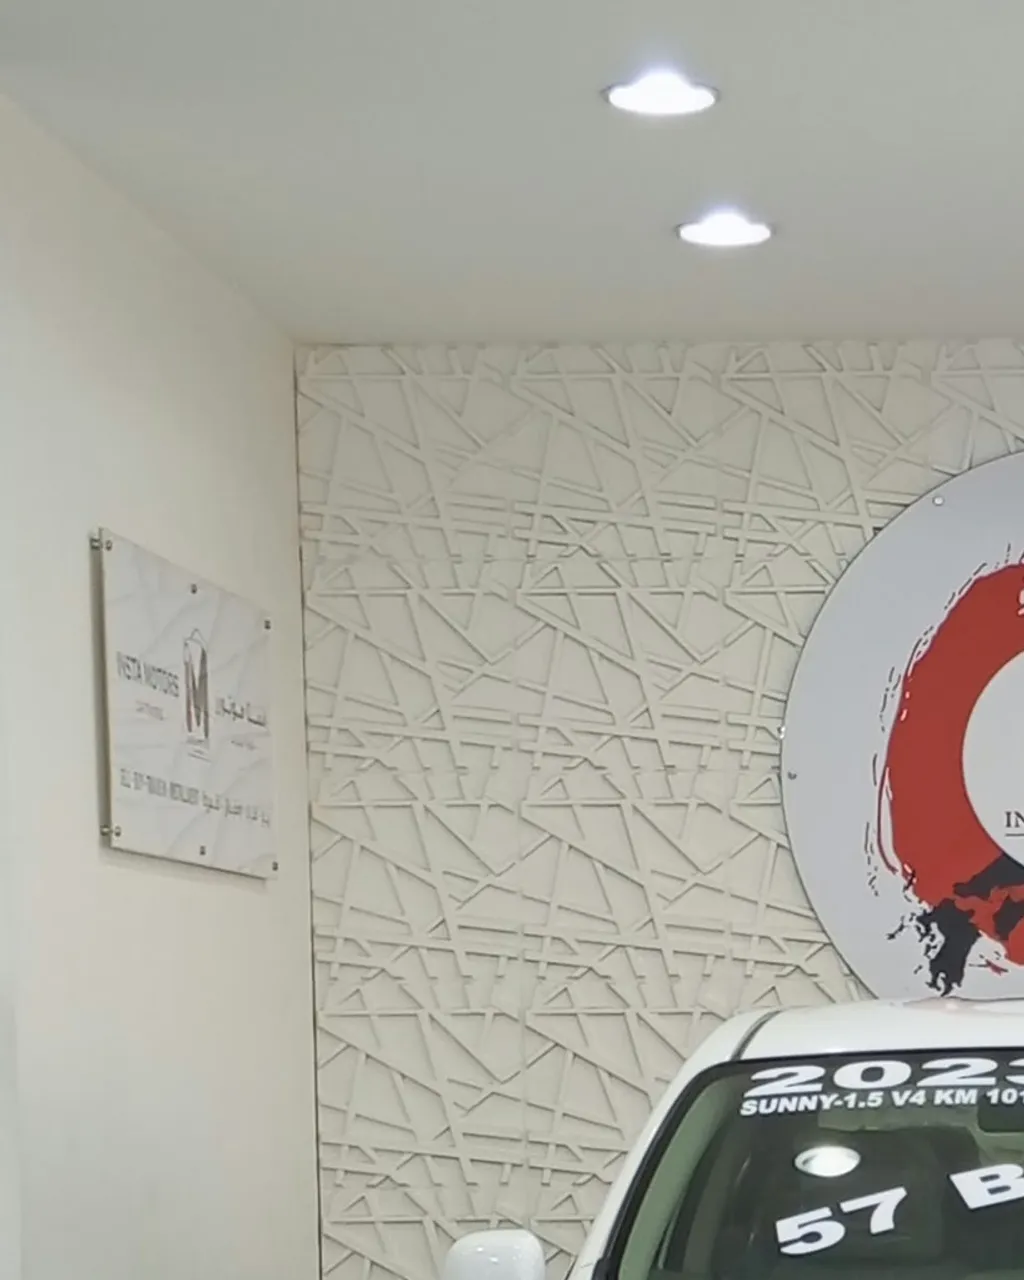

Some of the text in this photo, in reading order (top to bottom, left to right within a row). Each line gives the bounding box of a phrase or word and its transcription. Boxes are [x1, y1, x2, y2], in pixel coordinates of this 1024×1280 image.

[739, 1091, 884, 1117] SUNNY-1.5
[891, 1090, 926, 1107] V4
[934, 1089, 979, 1106] KM
[775, 1187, 908, 1256] 57
